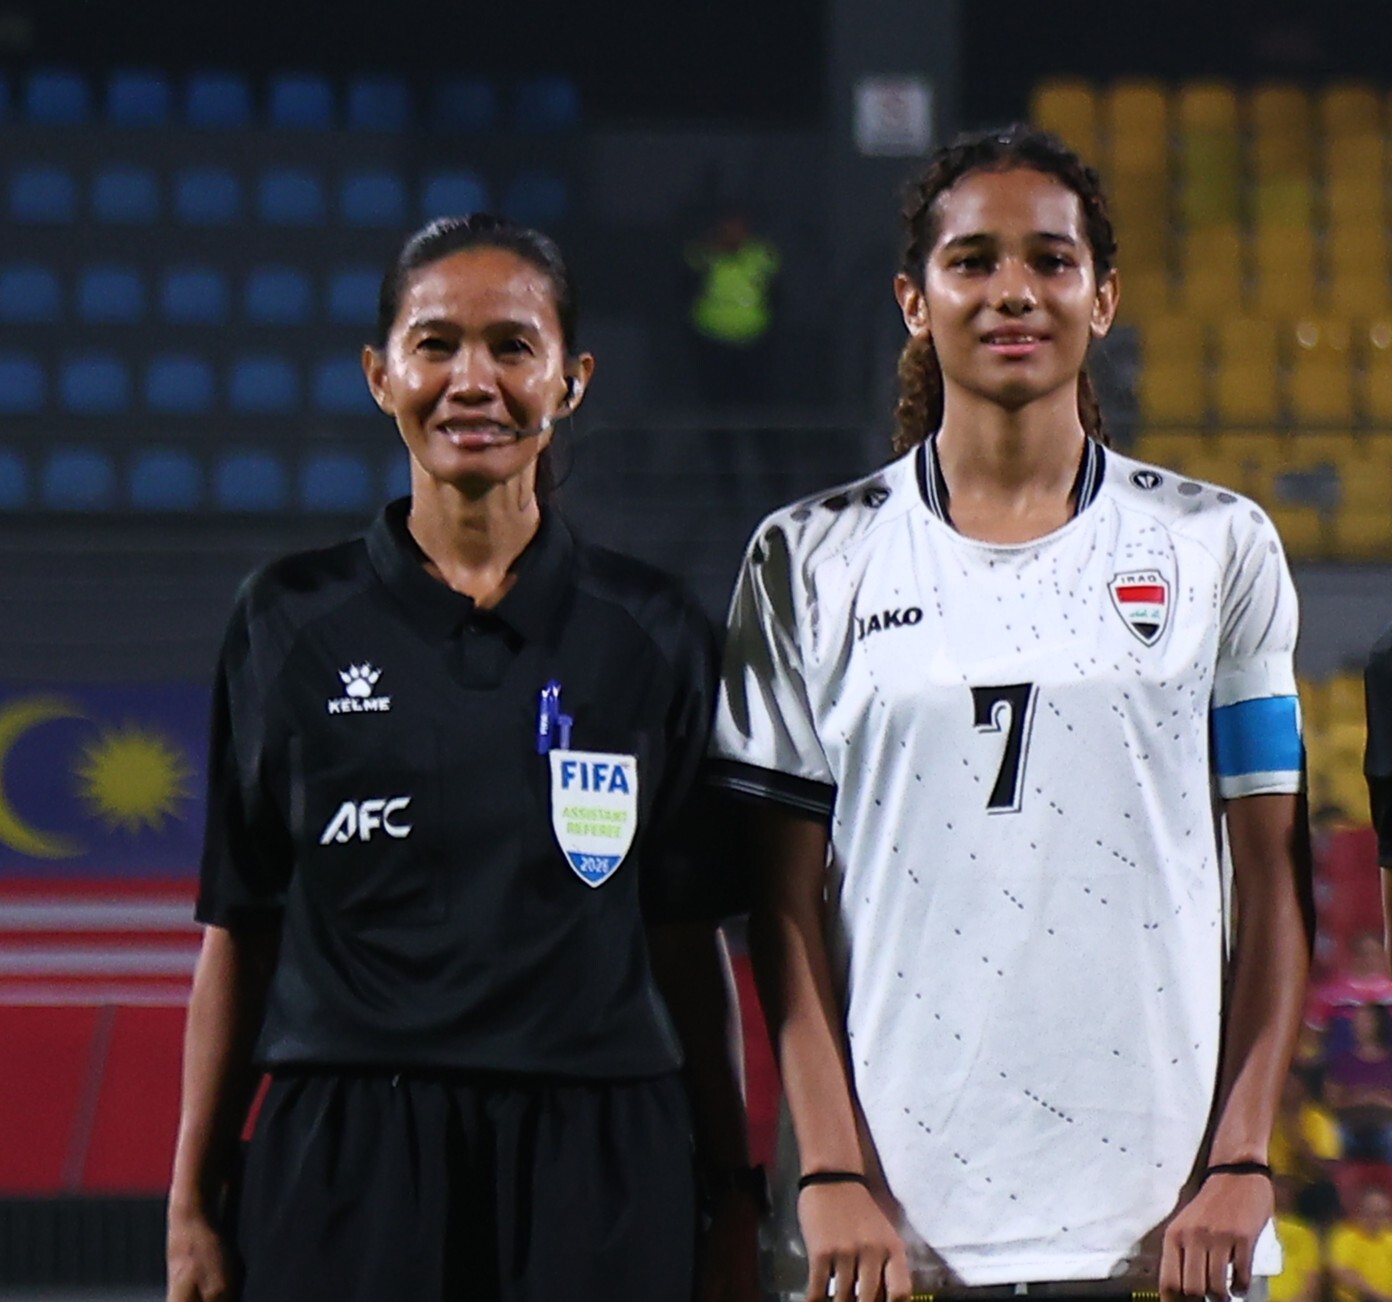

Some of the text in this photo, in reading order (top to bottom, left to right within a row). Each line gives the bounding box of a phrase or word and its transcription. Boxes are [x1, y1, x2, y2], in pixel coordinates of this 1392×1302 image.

[1121, 574, 1157, 584] IRAQ
[857, 606, 924, 641] JAKO
[328, 697, 391, 714] KELME
[970, 682, 1039, 816] 7
[560, 761, 630, 795] FIFA
[319, 797, 412, 845] AFC
[580, 856, 610, 873] 2026
